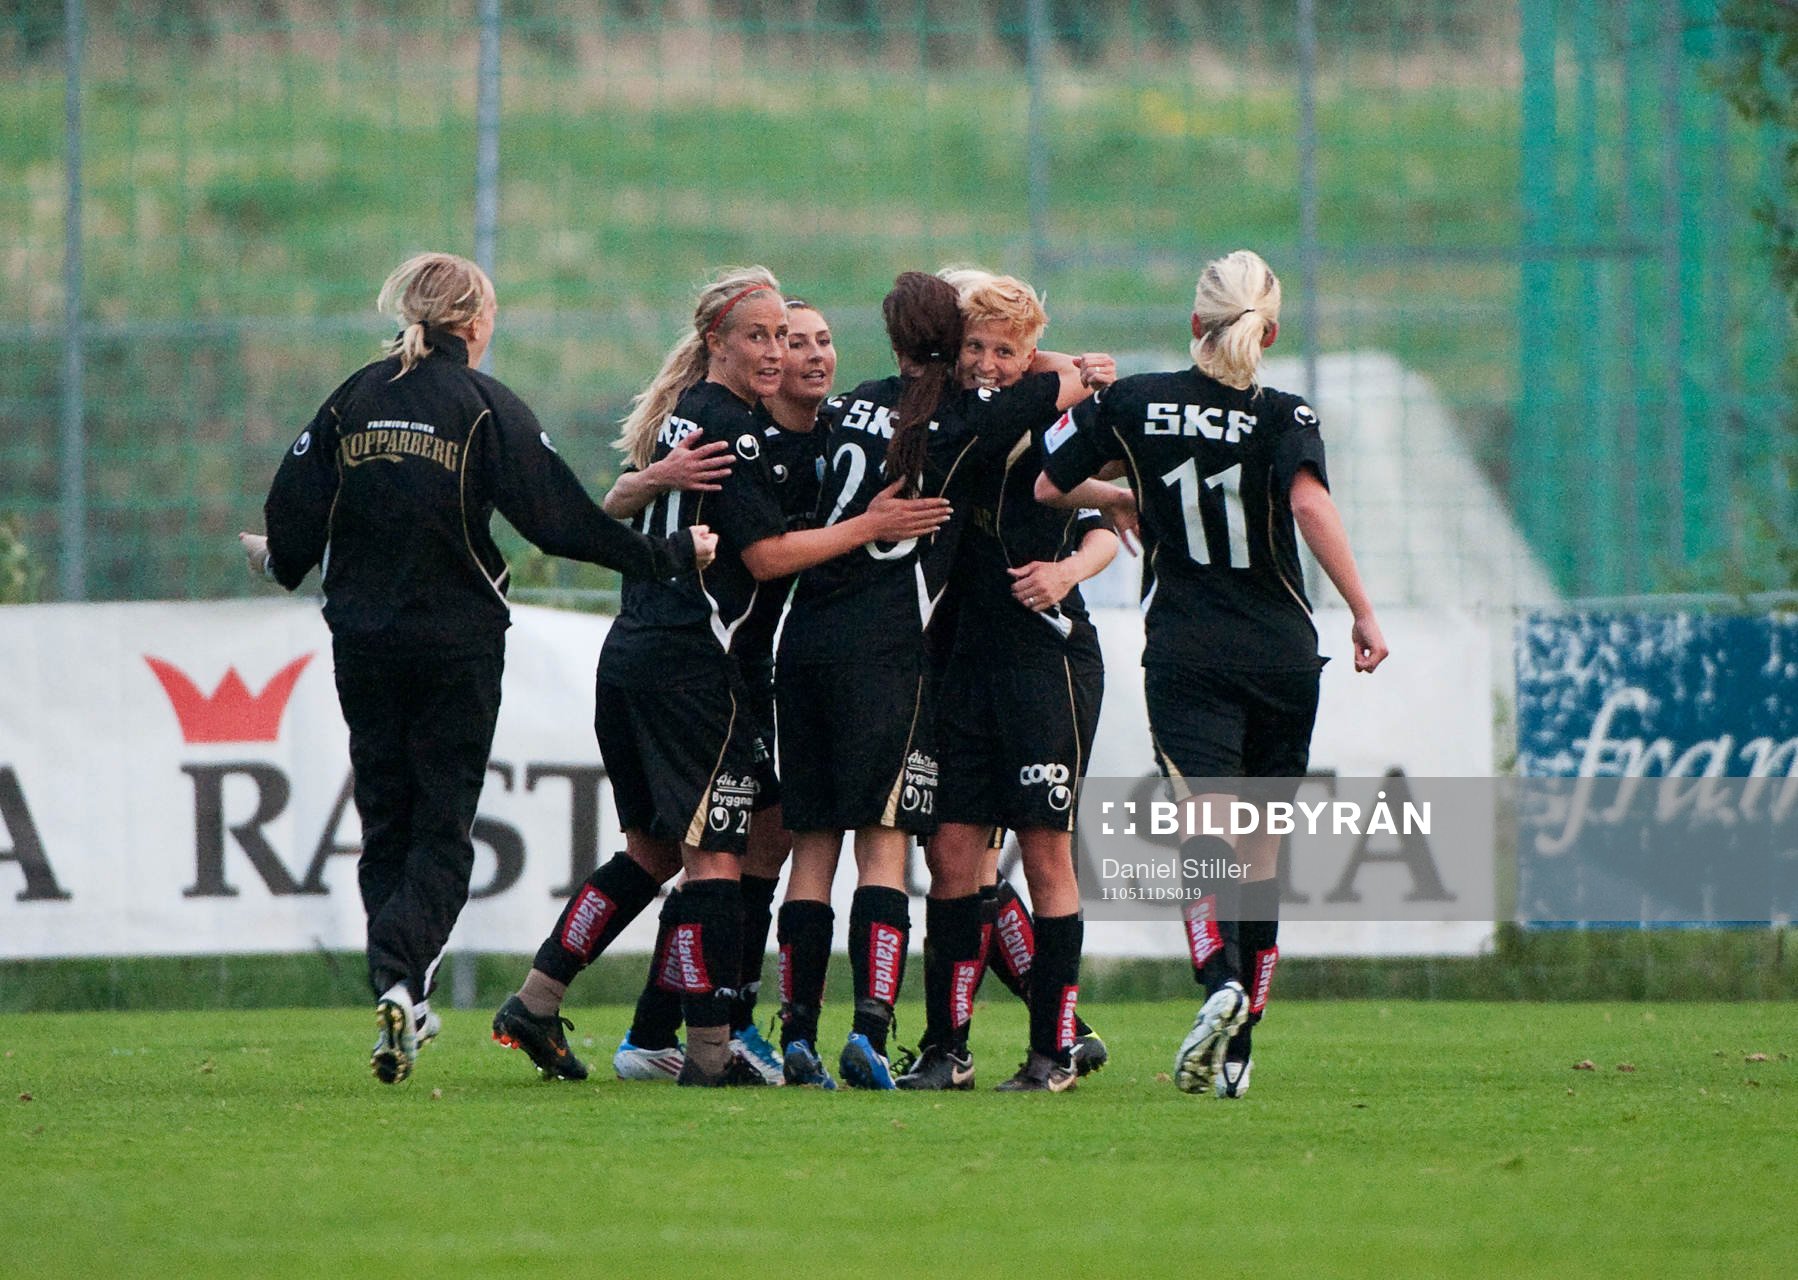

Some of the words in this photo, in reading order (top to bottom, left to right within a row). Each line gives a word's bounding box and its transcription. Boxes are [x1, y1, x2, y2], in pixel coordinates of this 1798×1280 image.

[657, 414, 698, 448] KF
[1144, 402, 1257, 443] SKF
[340, 429, 459, 472] KOPPARBERG
[1161, 456, 1251, 569] 11
[1020, 763, 1070, 787] coop
[566, 890, 607, 955] Stavdal
[678, 929, 706, 989] Stavdal
[874, 928, 898, 1001] Stavdal
